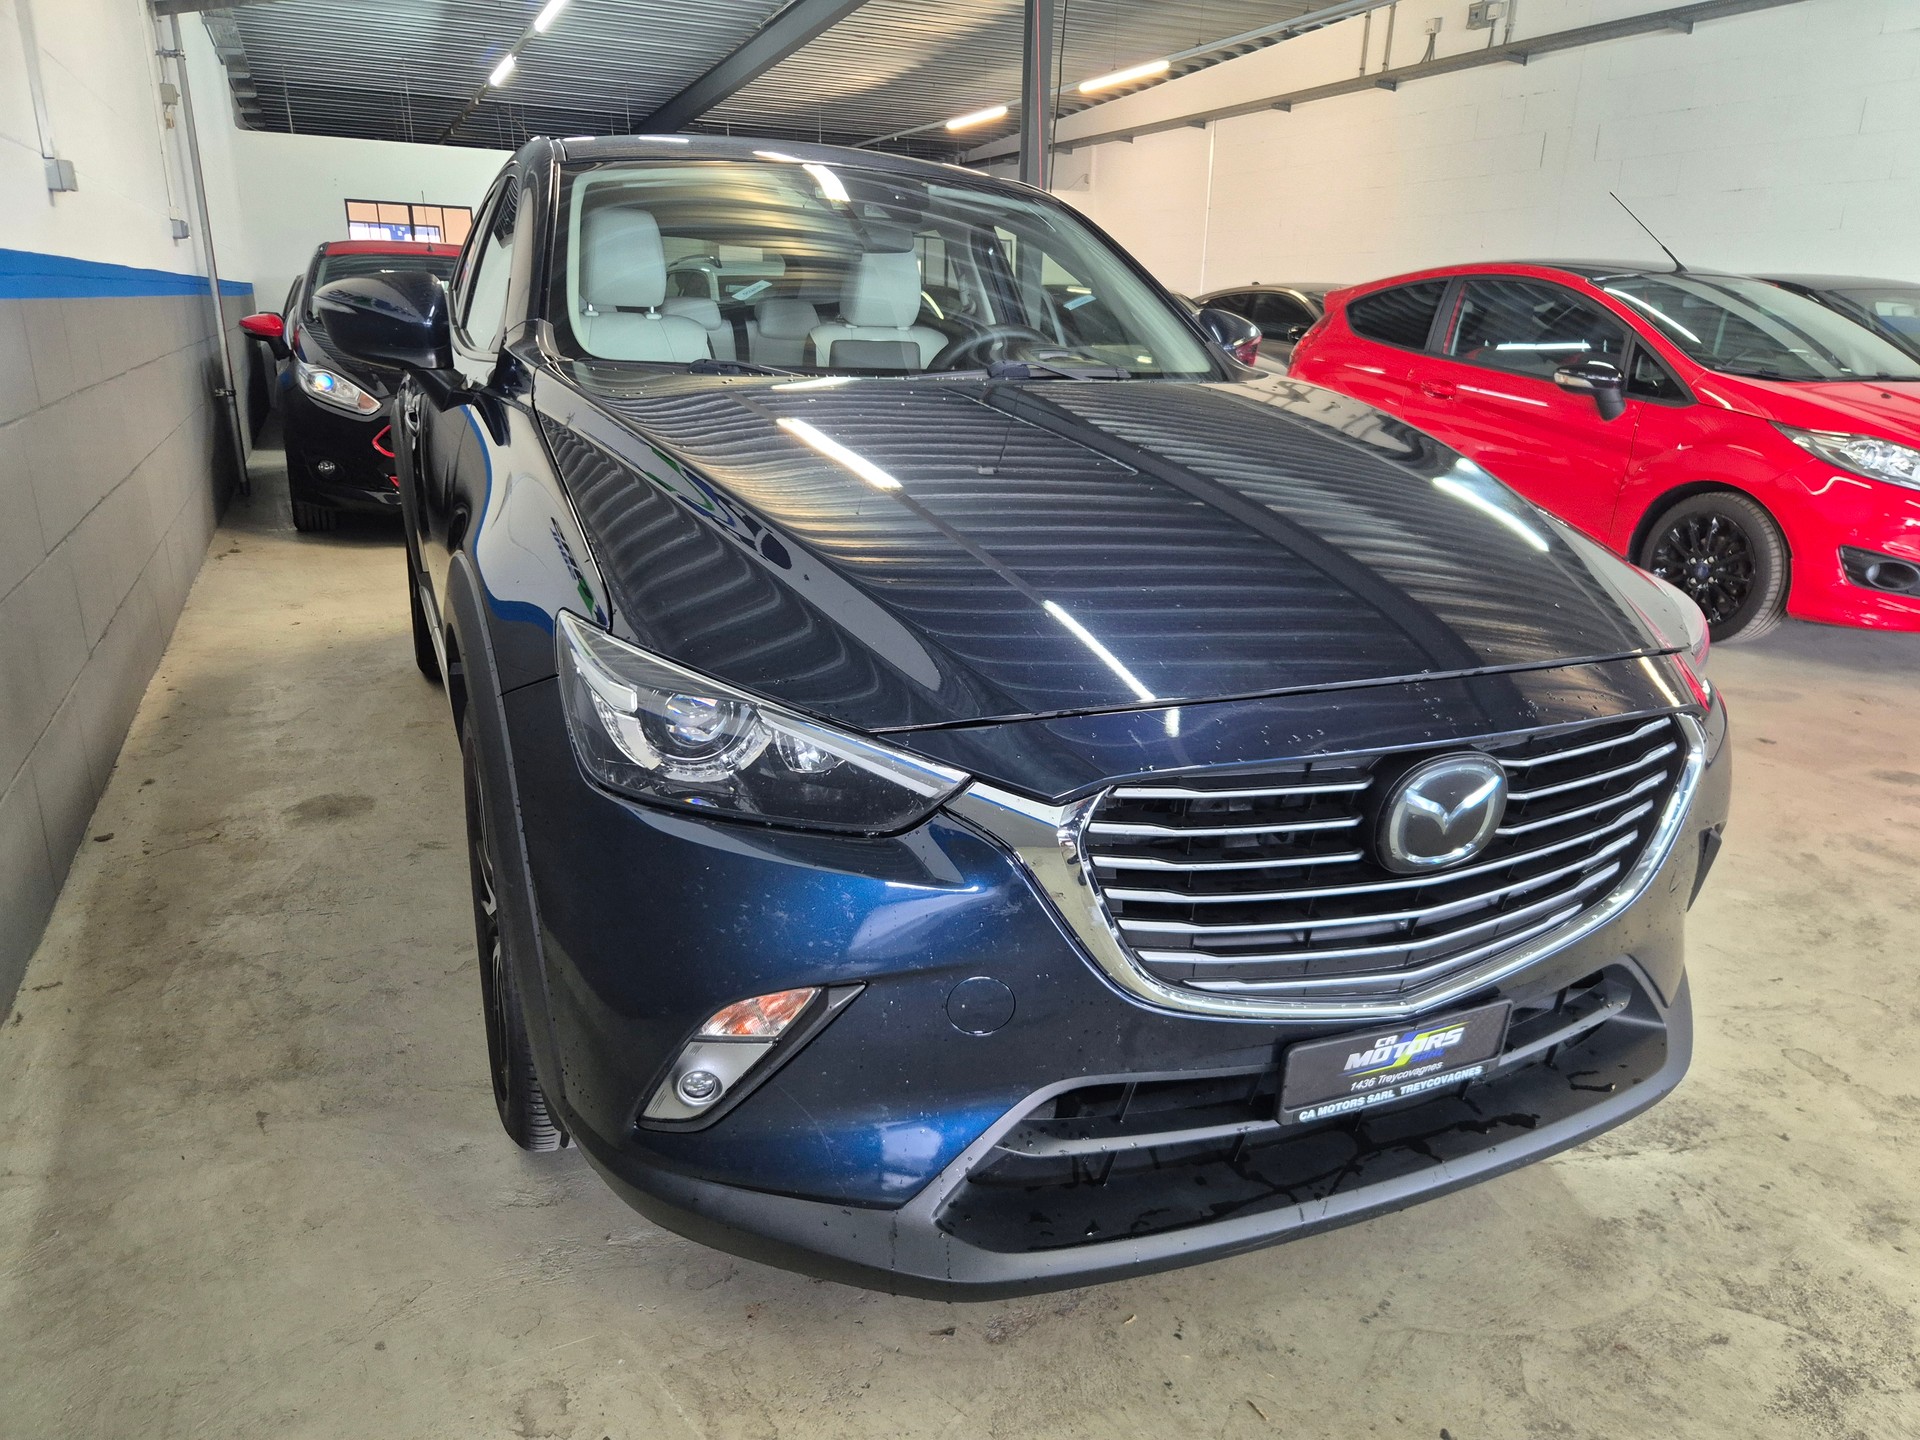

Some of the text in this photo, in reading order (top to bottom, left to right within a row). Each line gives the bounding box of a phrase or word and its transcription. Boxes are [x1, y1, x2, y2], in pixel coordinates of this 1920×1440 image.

[1343, 1027, 1465, 1071] MOTORS
[1374, 1035, 1398, 1048] CA
[1299, 1065, 1483, 1121] CA MOTORS SARL TREYCOVAGNES
[1350, 1061, 1443, 1091] 1436 Treycovagnes
